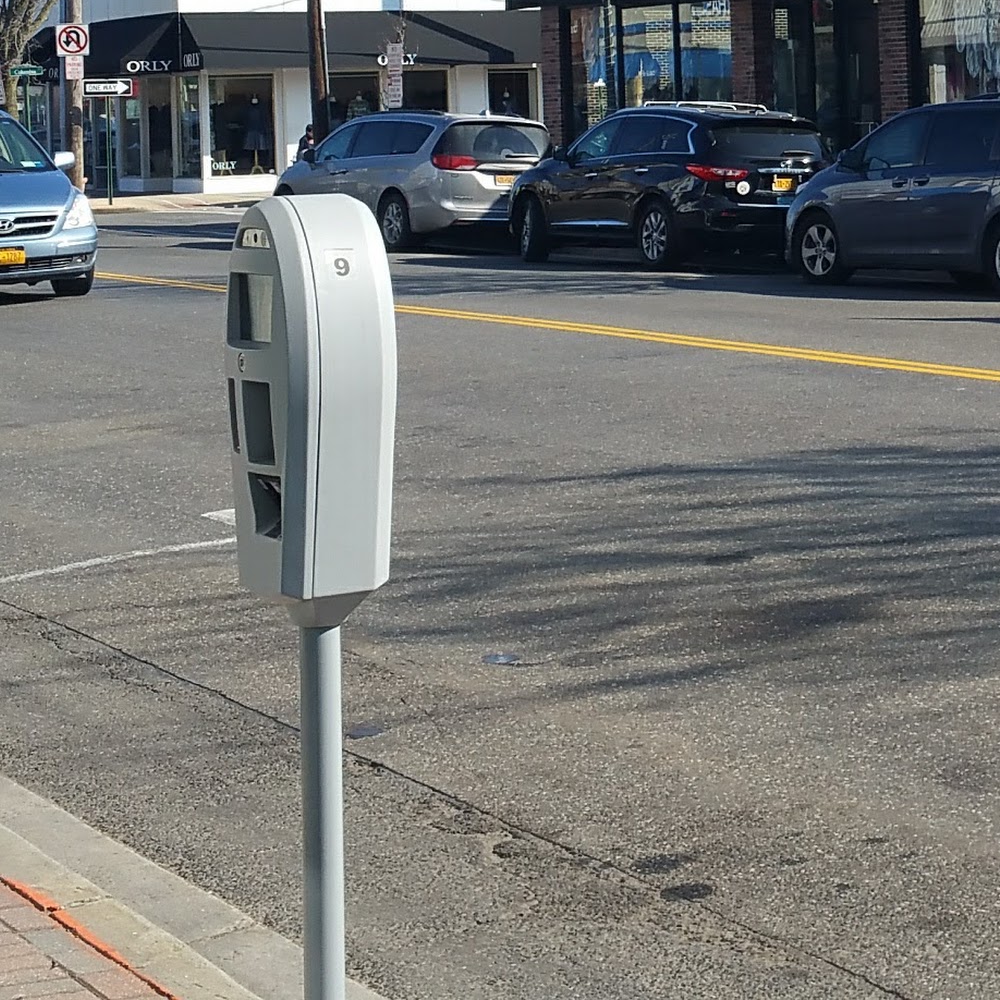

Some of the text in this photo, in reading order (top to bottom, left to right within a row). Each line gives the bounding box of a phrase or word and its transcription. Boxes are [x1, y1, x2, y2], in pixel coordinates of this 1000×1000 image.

[183, 53, 200, 68] ORLY
[377, 53, 417, 66] OLY
[126, 60, 172, 73] ORLY
[88, 84, 101, 92] ONE
[212, 160, 237, 171] ORLY
[333, 257, 350, 277] 9
